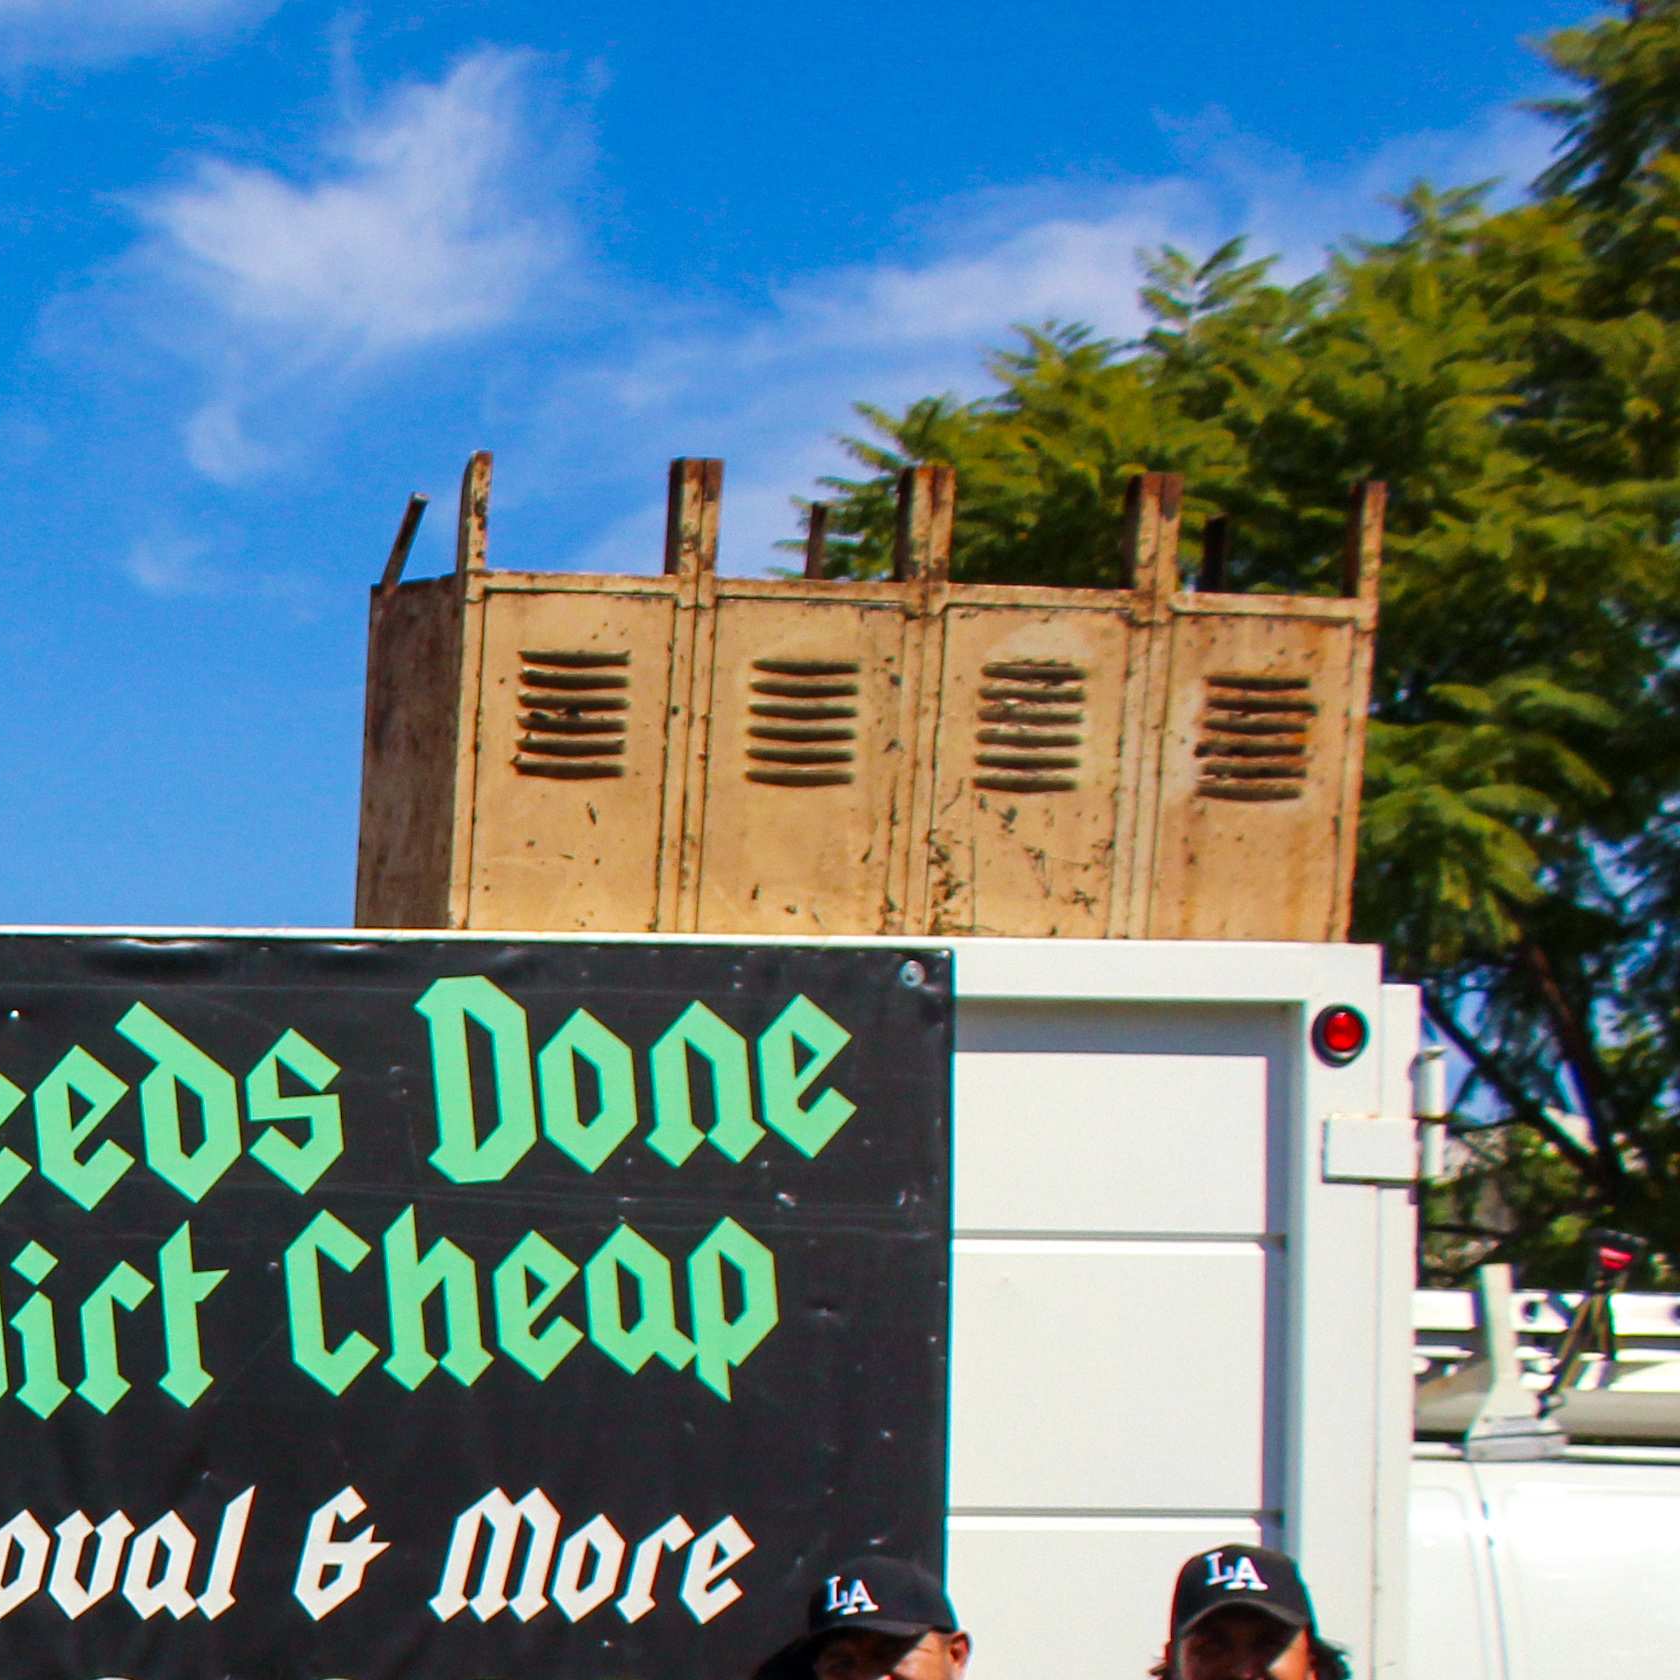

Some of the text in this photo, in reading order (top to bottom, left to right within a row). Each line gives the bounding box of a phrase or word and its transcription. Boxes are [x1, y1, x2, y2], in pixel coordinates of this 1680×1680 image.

[414, 976, 857, 1184] Done
[284, 1205, 779, 1401] Cheap
[295, 1486, 389, 1620] &
[431, 1488, 756, 1623] More
[826, 1575, 881, 1616] LA
[1204, 1551, 1269, 1592] LA
